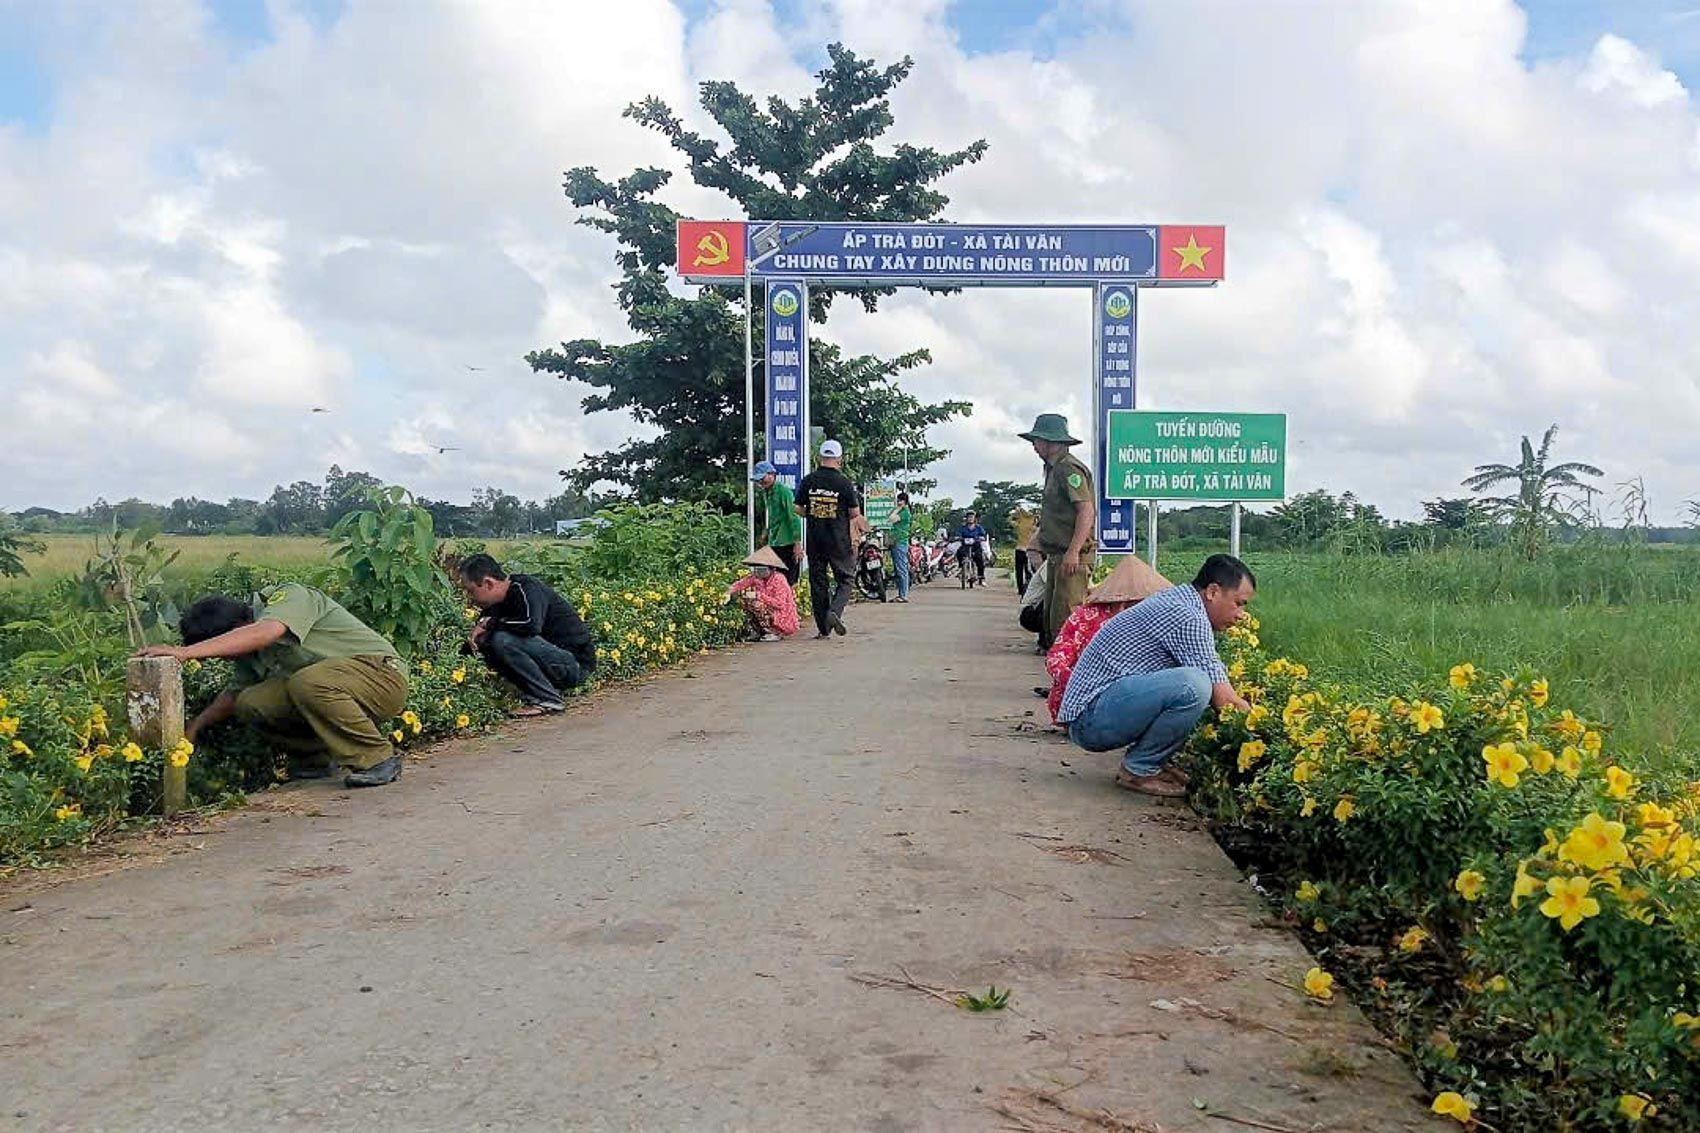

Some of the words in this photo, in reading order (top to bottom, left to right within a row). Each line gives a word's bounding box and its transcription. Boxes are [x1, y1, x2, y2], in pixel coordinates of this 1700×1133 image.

[843, 230, 867, 249] ẤP
[872, 232, 906, 249] TRÀ
[963, 233, 988, 250] XÃ
[993, 233, 1020, 250] TÀI
[774, 254, 839, 269] CHUNG
[844, 255, 875, 270] TAY
[881, 253, 917, 270] XÂY
[923, 254, 975, 273] DỰNG
[980, 255, 1033, 272] NÔNG
[1039, 254, 1088, 272] THÔN
[1093, 255, 1130, 272] MỚI
[1155, 416, 1196, 437] TUYẾN
[1199, 418, 1241, 438] ĐƯỜNG
[1118, 444, 1152, 464] NÔNG
[1154, 444, 1188, 464] THÔN
[1191, 444, 1215, 464] MỚI
[1250, 441, 1278, 464] MẪU
[1123, 469, 1141, 490] ẤP
[1144, 470, 1167, 490] TRÀ
[1171, 470, 1200, 492] ĐÓT,
[1203, 471, 1219, 490] XÃ
[1223, 470, 1243, 490] TÀI
